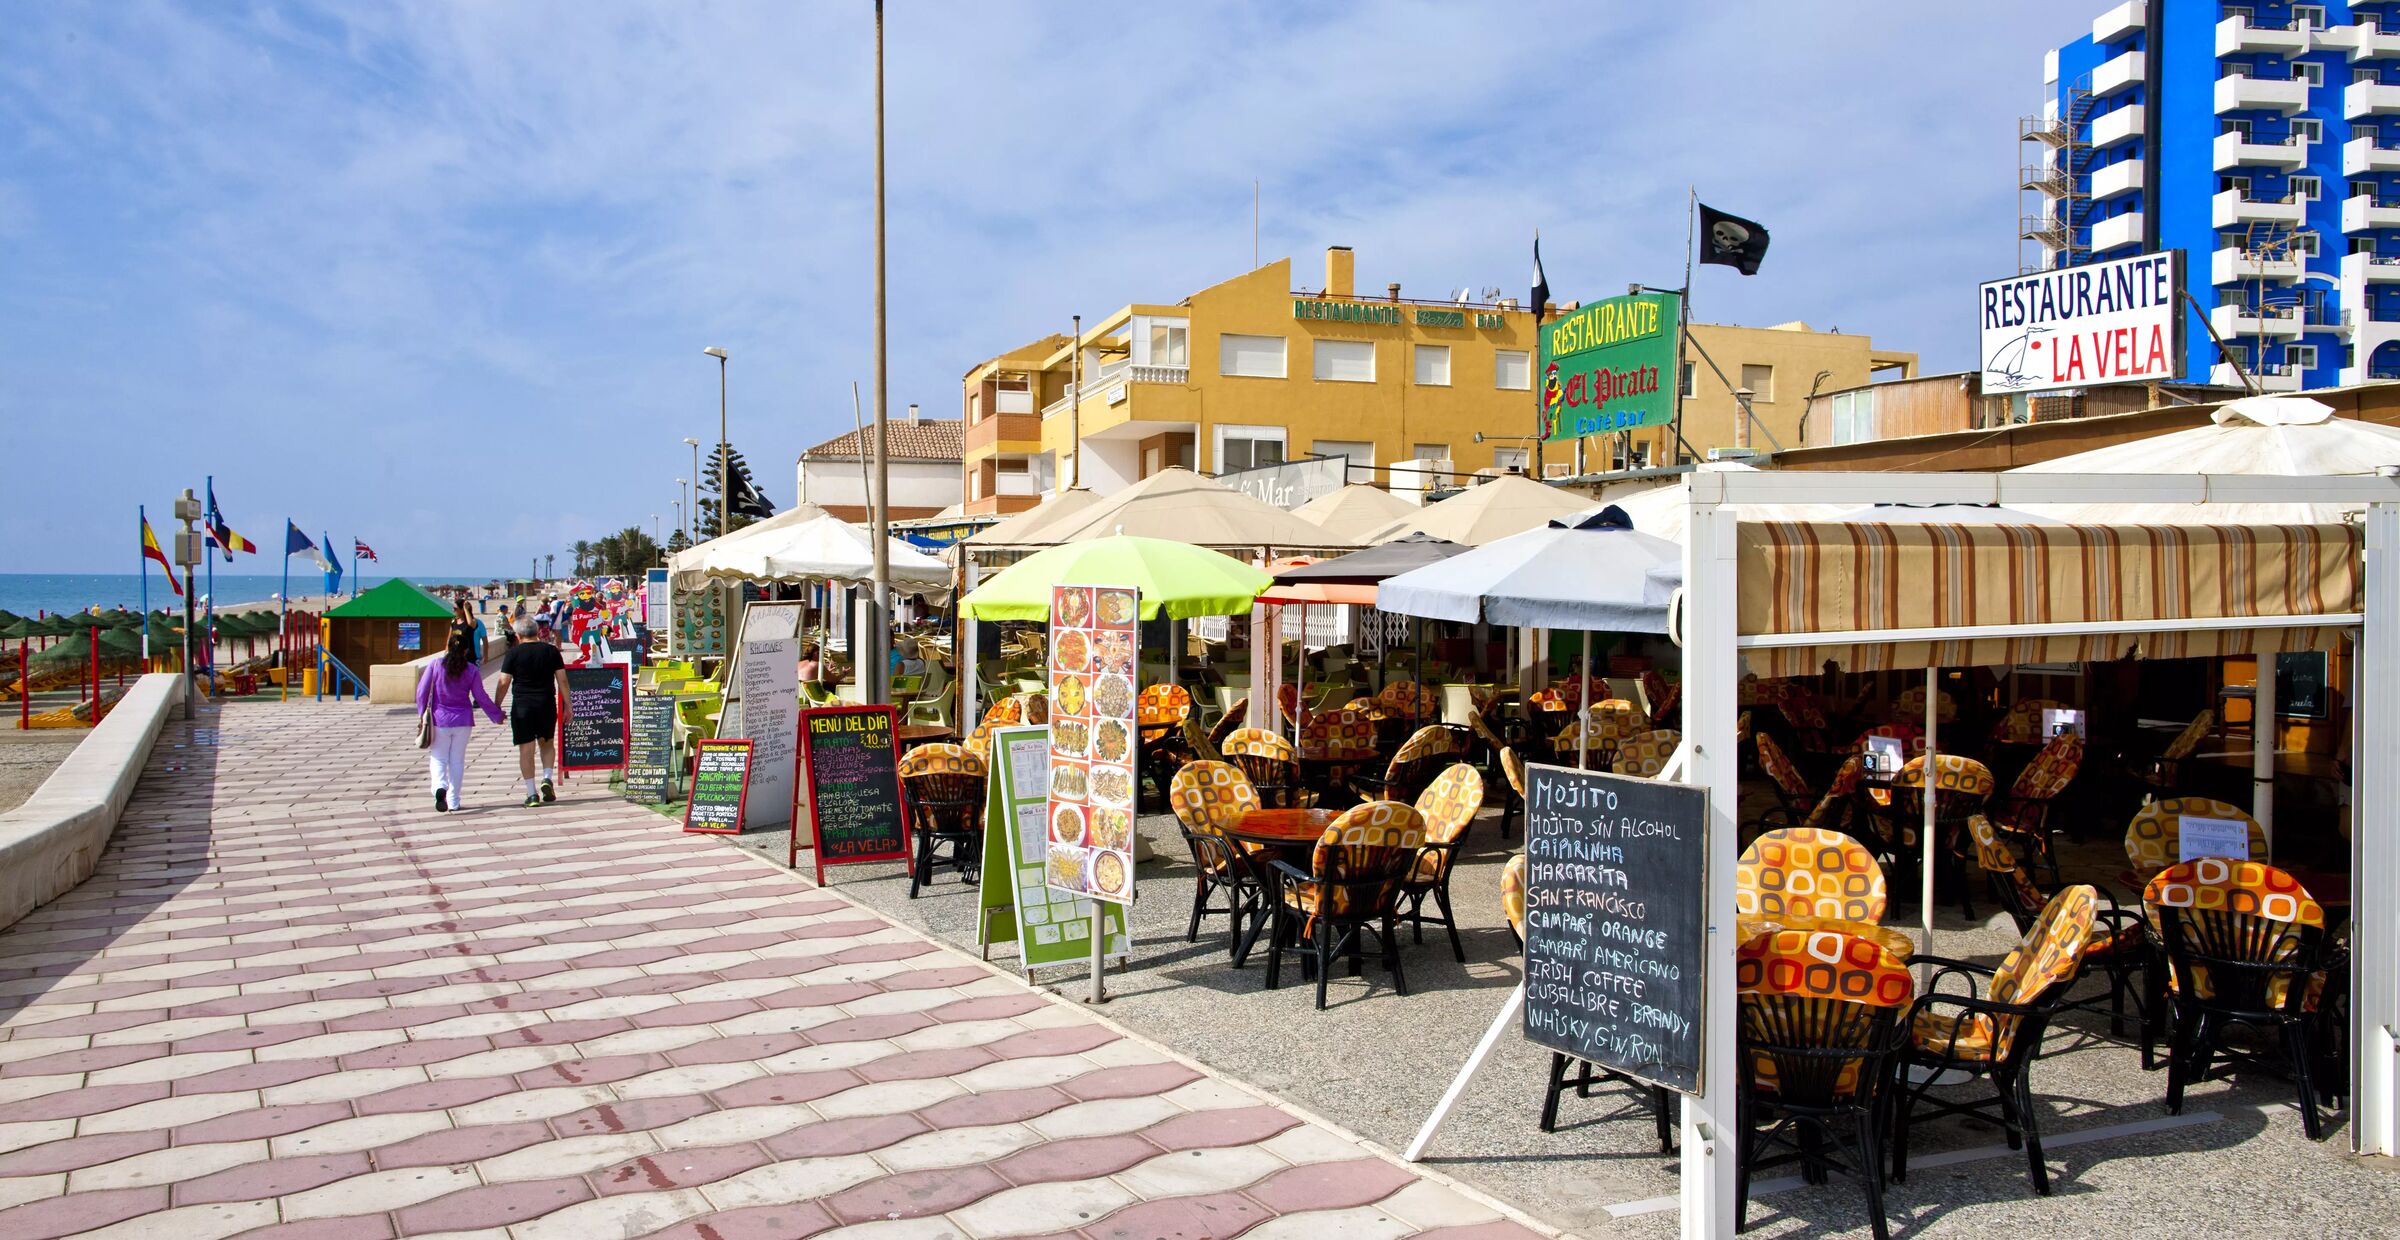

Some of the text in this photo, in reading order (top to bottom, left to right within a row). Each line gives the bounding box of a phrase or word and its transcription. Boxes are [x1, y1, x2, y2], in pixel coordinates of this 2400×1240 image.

[1985, 256, 2168, 330] RESTAURANTE
[1294, 300, 1504, 330] RESTAURANTE Berlin BAR
[1552, 301, 1659, 356] RESTAURANTE
[2052, 323, 2168, 383] LA VELA
[1565, 362, 1659, 410] El Pirata
[1575, 408, 1646, 435] Café Bar
[1257, 477, 1294, 507] Mar
[750, 641, 783, 653] RACIONES
[845, 715, 866, 732] DEL
[865, 733, 879, 746] 10
[695, 783, 708, 791] COLD
[861, 802, 893, 814] TOMATE
[1621, 816, 1681, 841] ALCOHOL
[1530, 861, 1629, 890] MARGARITA
[1527, 885, 1561, 908] SAN
[1601, 920, 1669, 951] ORANGE
[1593, 946, 1680, 981] AMERICANO
[1582, 969, 1647, 999] COFFEE
[1630, 1002, 1691, 1041] BRANDY
